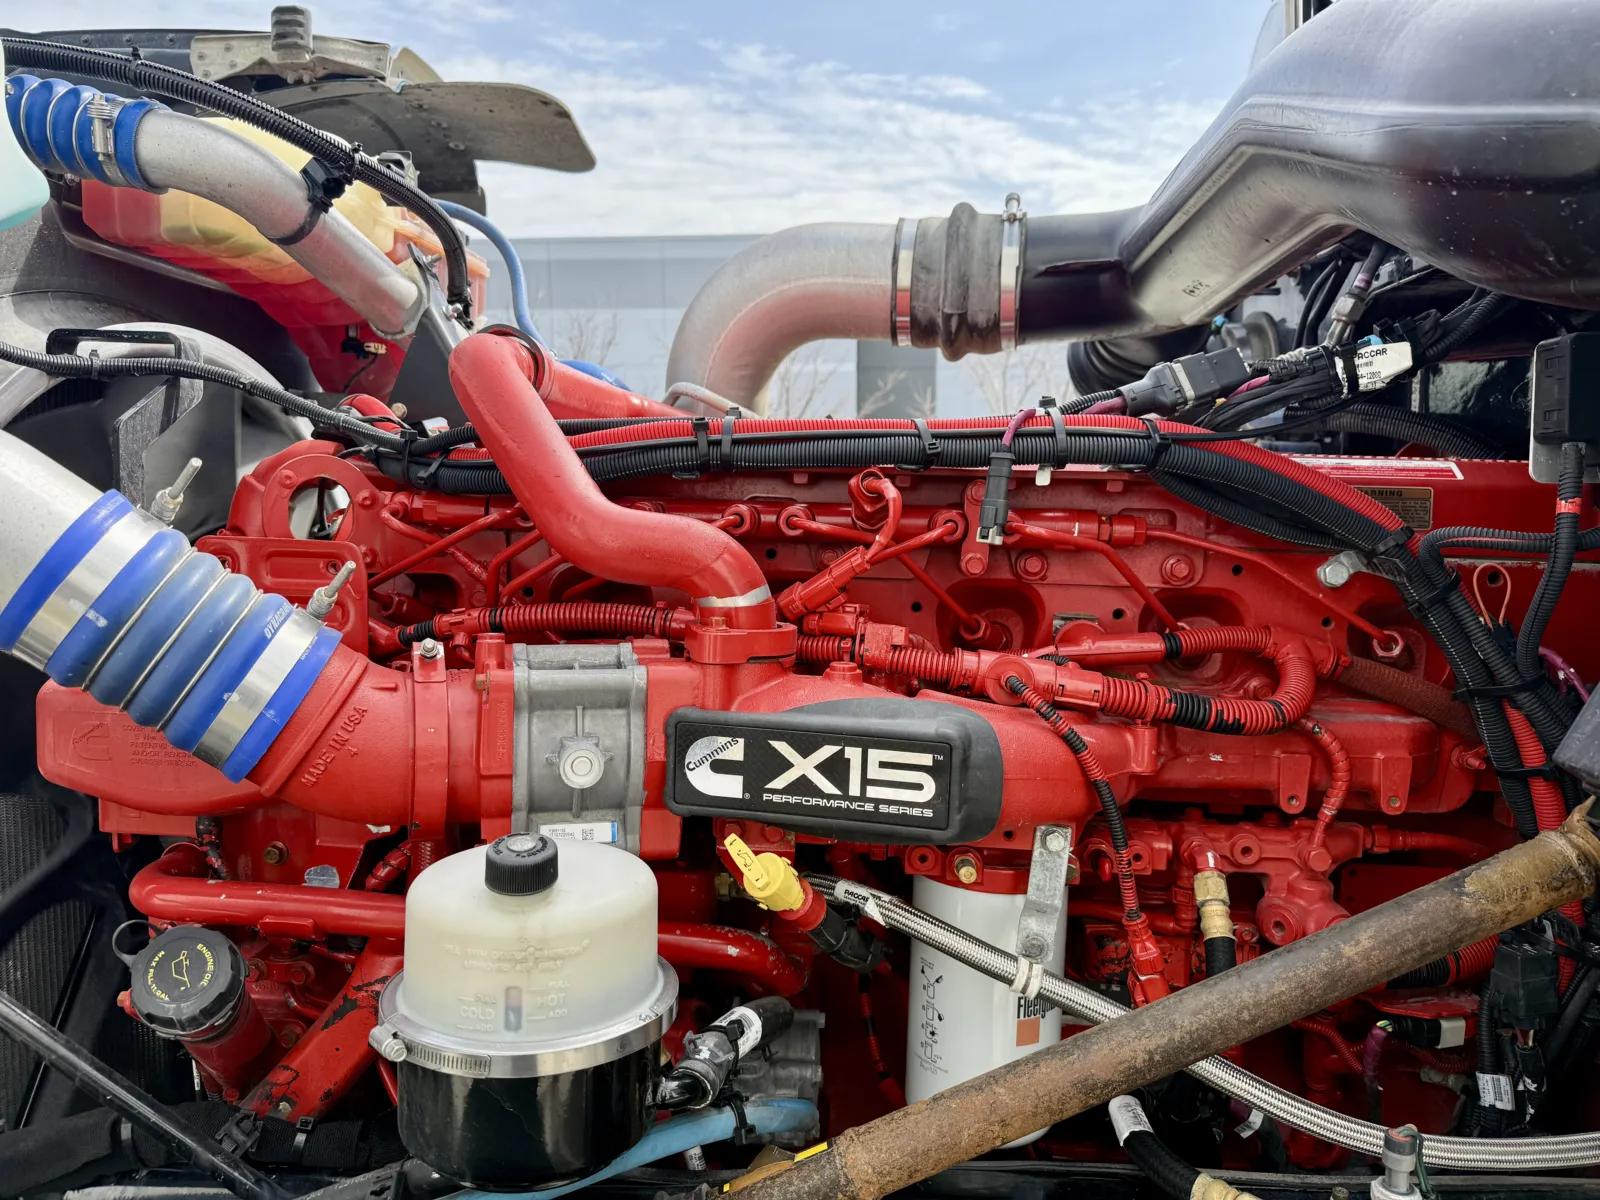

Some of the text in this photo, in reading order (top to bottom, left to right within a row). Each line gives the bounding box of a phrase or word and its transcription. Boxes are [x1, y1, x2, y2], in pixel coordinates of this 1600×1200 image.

[1361, 489, 1403, 497] ARNING
[300, 748, 336, 787] MADE
[328, 731, 350, 752] IN
[340, 705, 368, 733] USA
[685, 736, 740, 773] Cummins
[763, 739, 936, 803] X15
[762, 793, 934, 818] PERFORMANCE SERIES
[150, 950, 165, 967] MAX
[196, 943, 214, 972] ENGINE
[536, 991, 568, 1008] HOT
[459, 1005, 496, 1020] COLD
